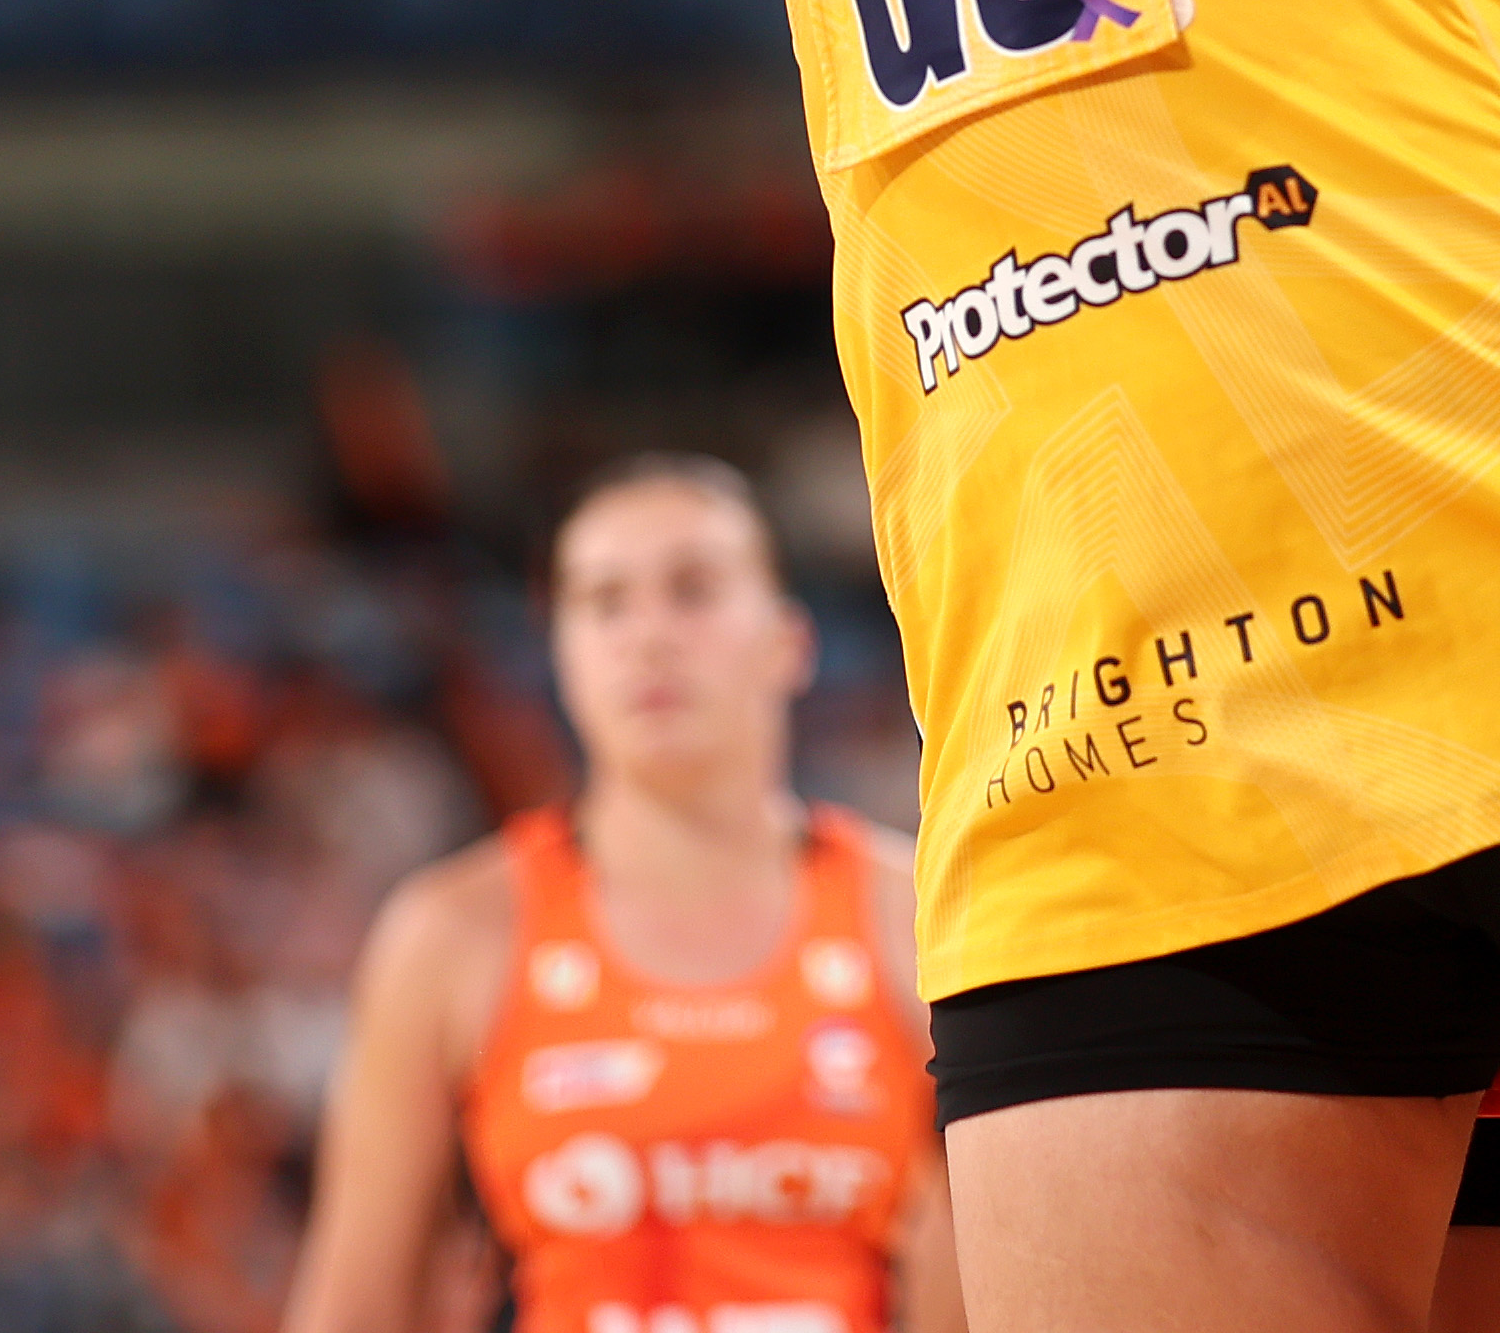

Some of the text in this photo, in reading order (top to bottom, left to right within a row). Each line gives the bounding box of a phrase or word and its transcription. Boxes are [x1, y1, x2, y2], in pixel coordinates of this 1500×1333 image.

[901, 192, 1254, 395] Protector
[1007, 569, 1405, 748] BRIGHTON
[985, 698, 1209, 809] HOMES
